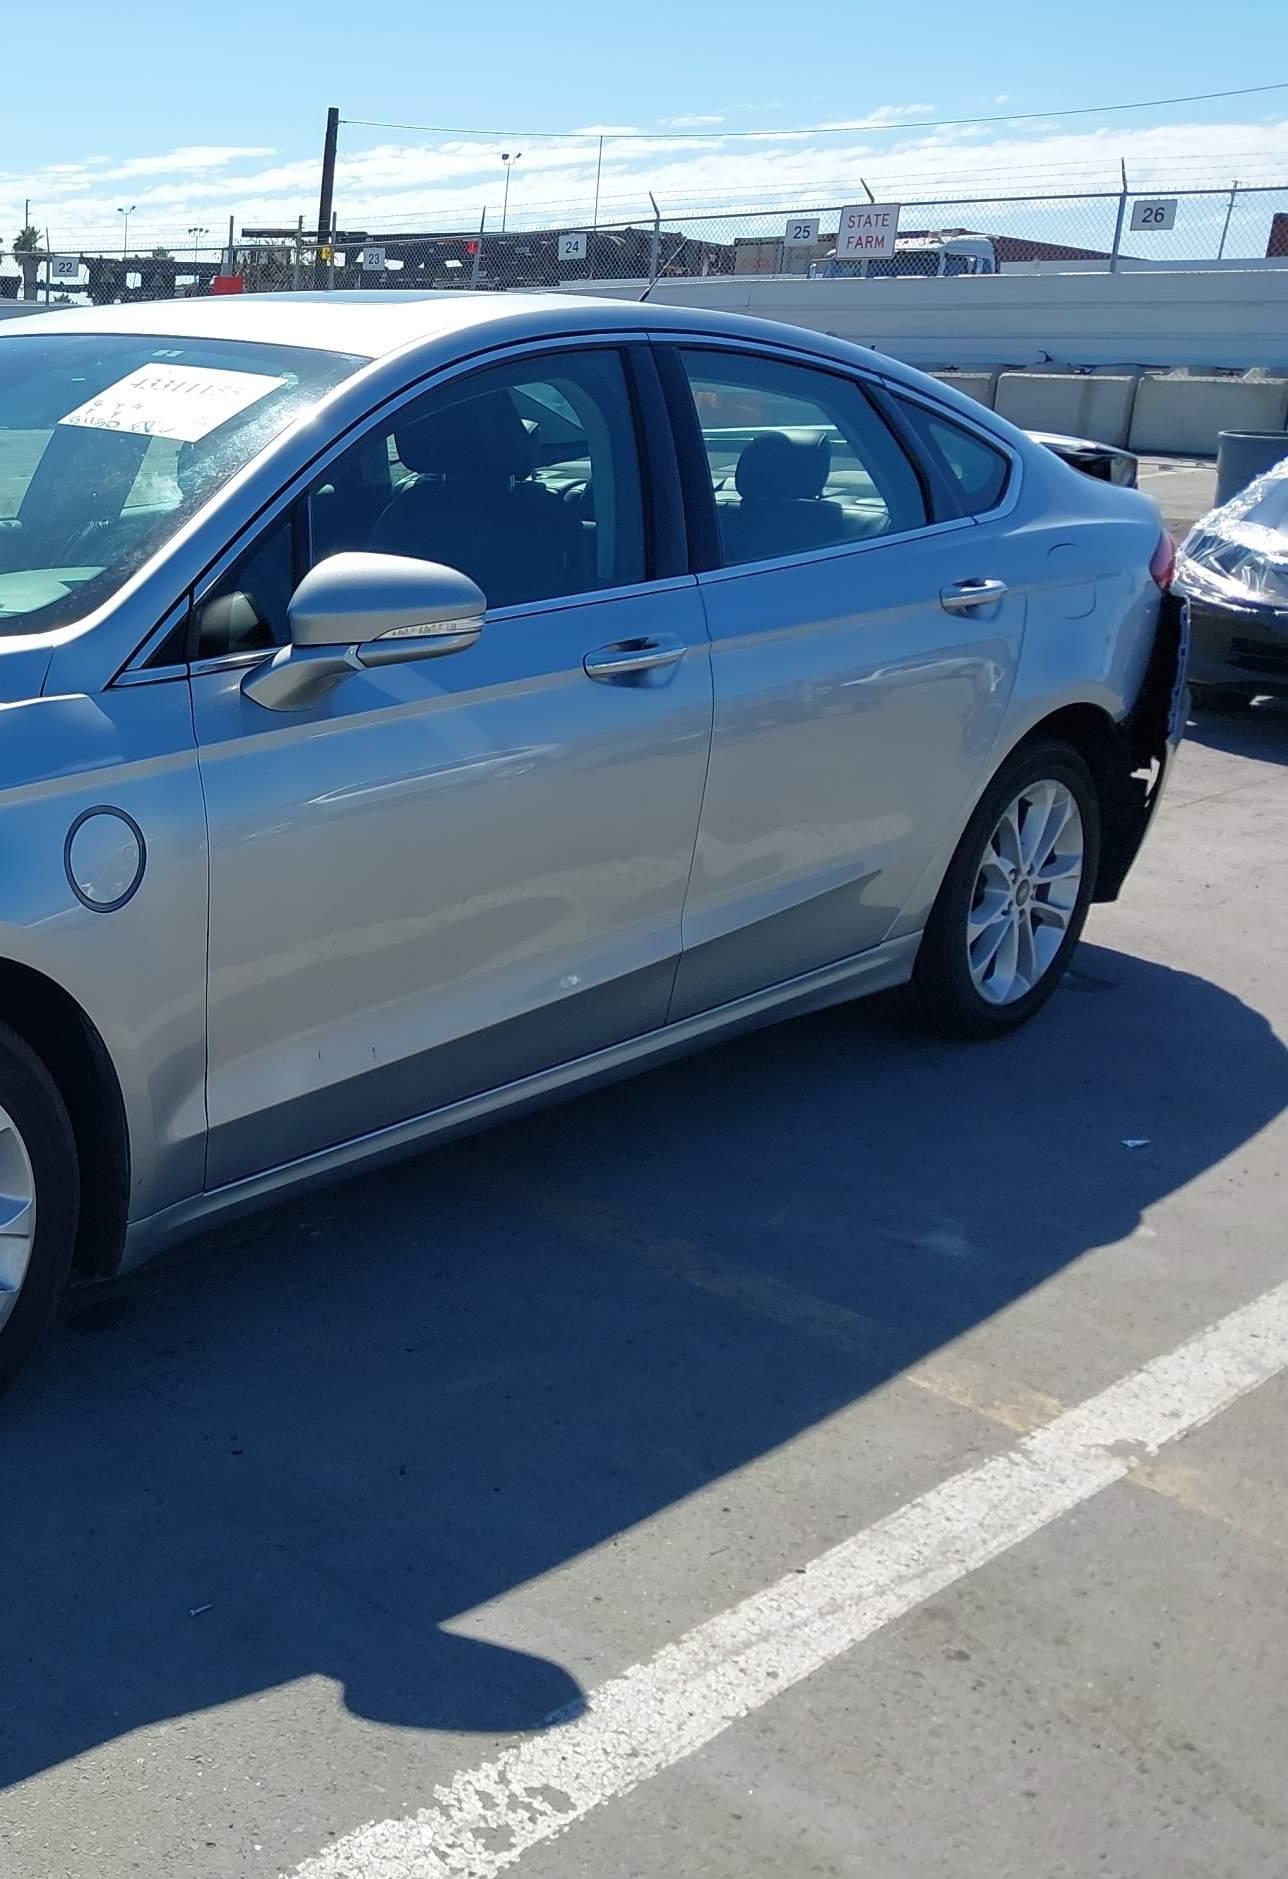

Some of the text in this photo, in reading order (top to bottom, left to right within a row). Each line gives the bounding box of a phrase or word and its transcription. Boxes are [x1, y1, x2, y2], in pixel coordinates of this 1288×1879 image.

[847, 214, 890, 229] STATE
[1142, 206, 1165, 223] 26
[793, 226, 811, 239] 25
[565, 240, 579, 254] 24
[846, 235, 885, 250] FARM
[368, 253, 380, 265] 23
[58, 262, 73, 273] 22
